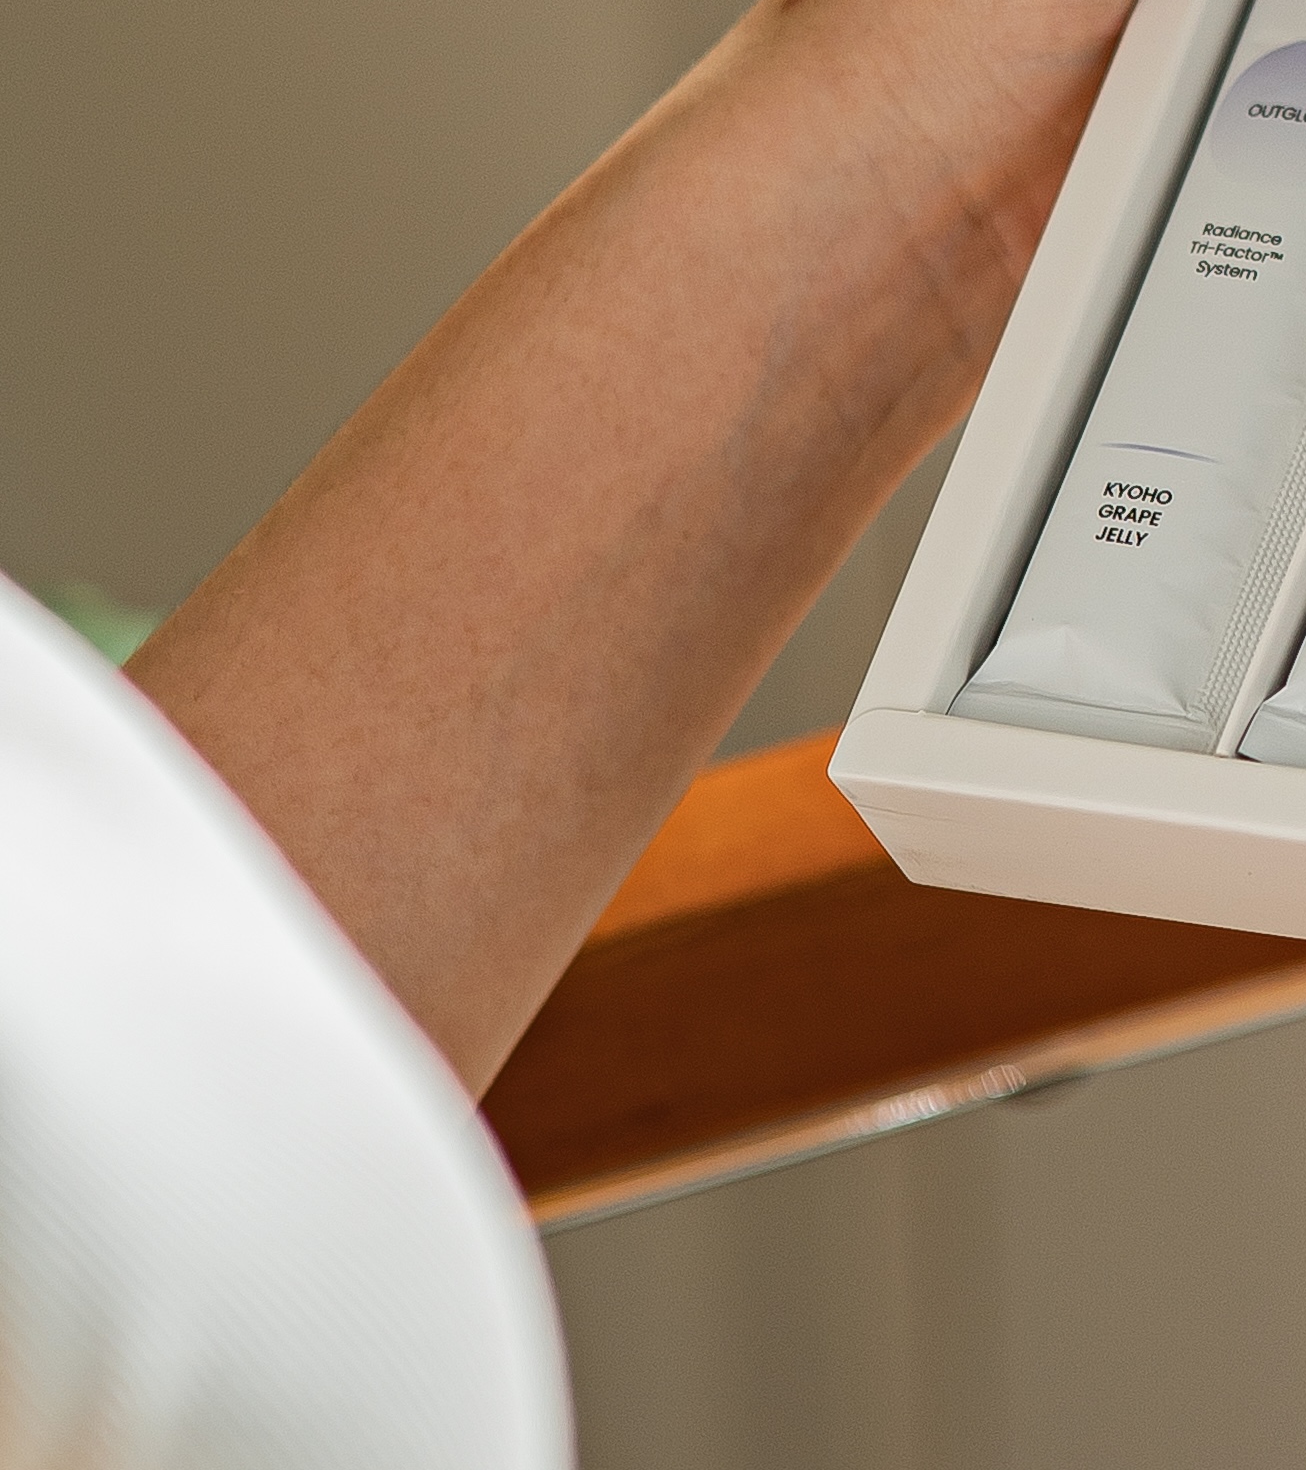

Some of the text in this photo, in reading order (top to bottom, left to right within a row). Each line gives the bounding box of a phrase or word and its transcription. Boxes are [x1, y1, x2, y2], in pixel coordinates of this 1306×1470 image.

[1203, 223, 1282, 245] Radiance
[1196, 261, 1257, 280] System
[1103, 483, 1172, 504] KYOHO
[1099, 505, 1162, 526] GRAPE
[1096, 527, 1148, 546] JELLY
